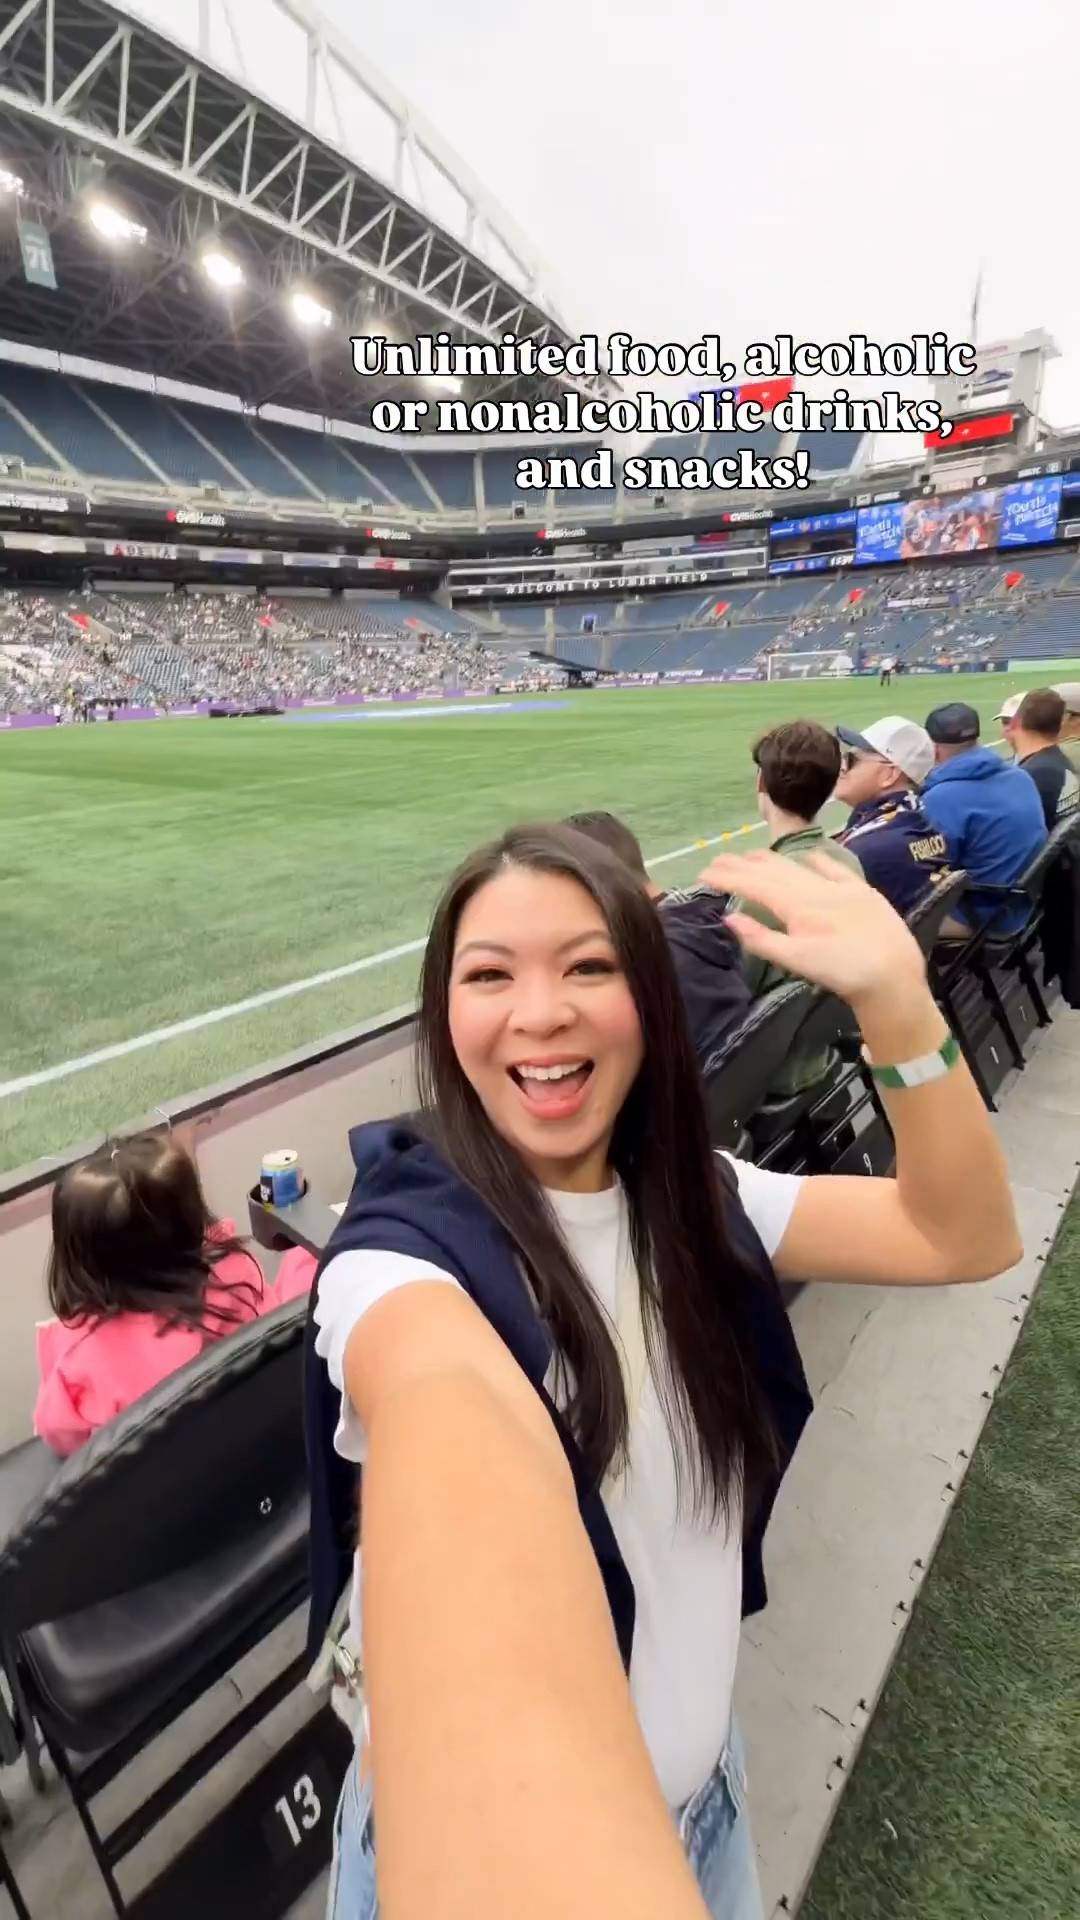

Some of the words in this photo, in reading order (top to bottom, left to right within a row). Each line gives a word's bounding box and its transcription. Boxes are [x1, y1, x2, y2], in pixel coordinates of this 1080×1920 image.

[506, 582, 575, 595] WELCOME
[584, 579, 600, 590] TO
[608, 573, 656, 589] LUMEN
[665, 571, 708, 584] FIELD
[274, 1773, 321, 1847] 13
